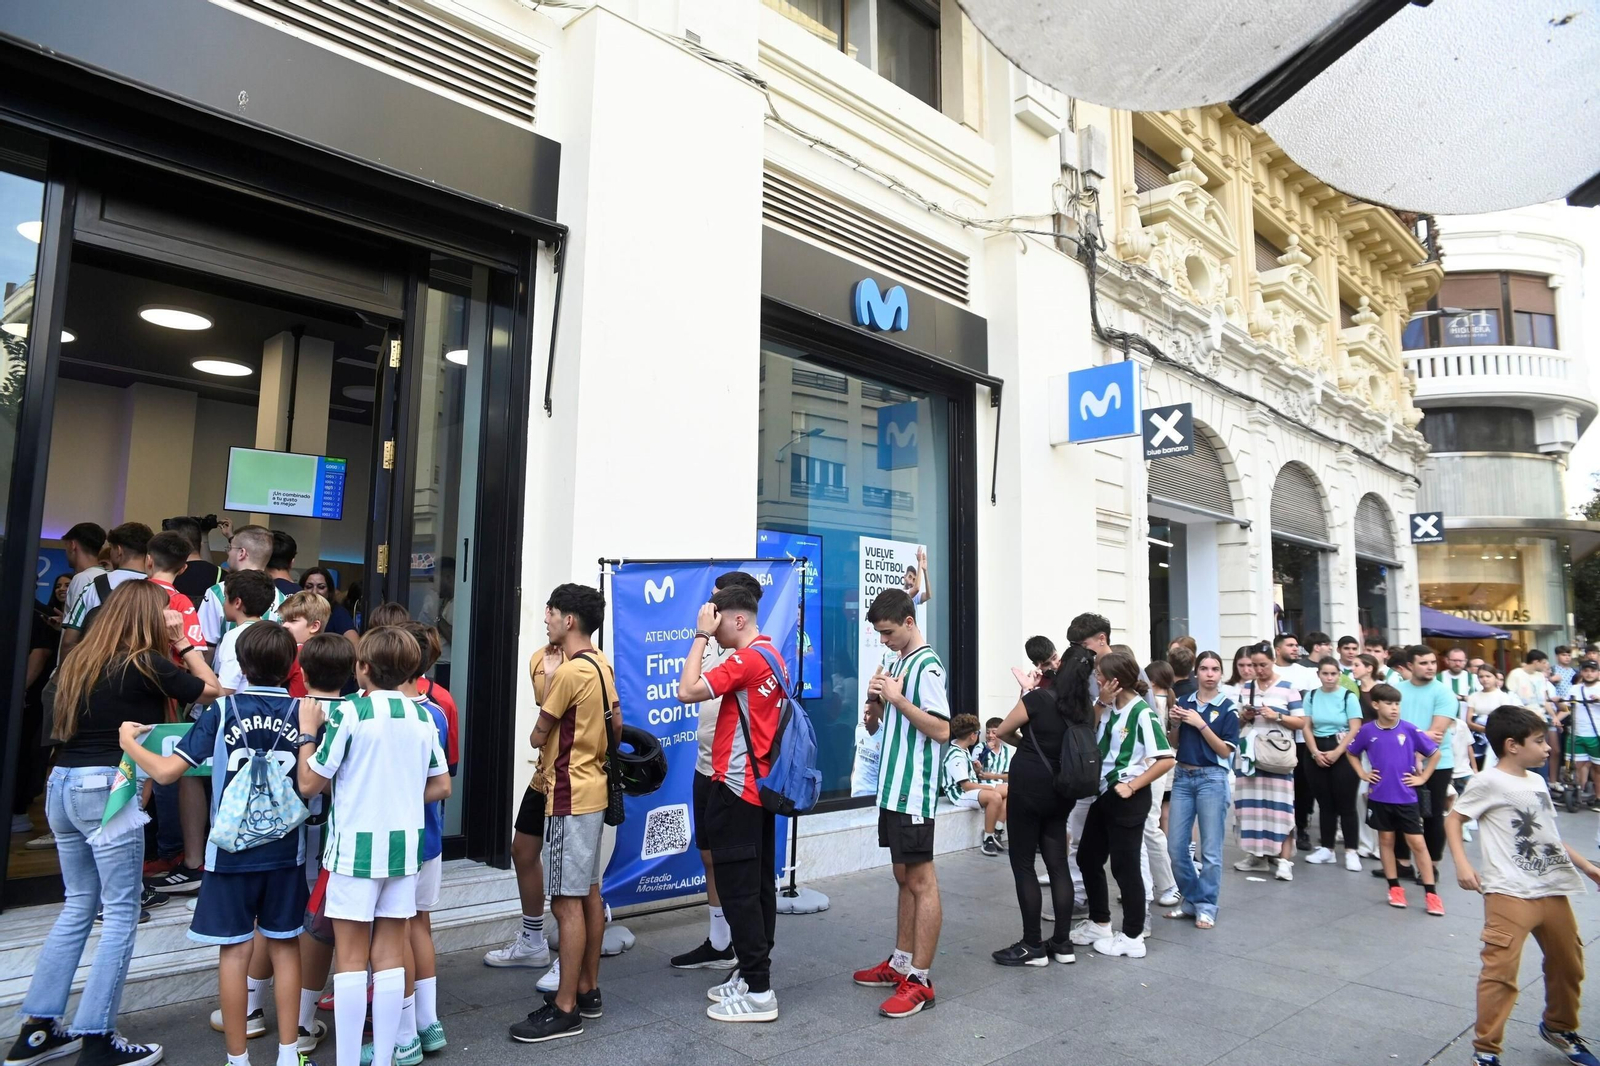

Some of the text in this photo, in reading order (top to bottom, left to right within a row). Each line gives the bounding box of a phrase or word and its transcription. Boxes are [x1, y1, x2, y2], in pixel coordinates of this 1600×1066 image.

[1147, 445, 1189, 456] blue banana
[865, 546, 894, 559] VUELVE
[865, 559, 905, 573] EL FÚTBOL
[865, 572, 882, 584] CON
[865, 585, 876, 596] LO
[645, 627, 697, 643] ATENCIÓN
[646, 679, 680, 701] aut
[648, 705, 682, 725] con
[224, 715, 299, 746] CARRACED
[639, 872, 672, 885] Estadio
